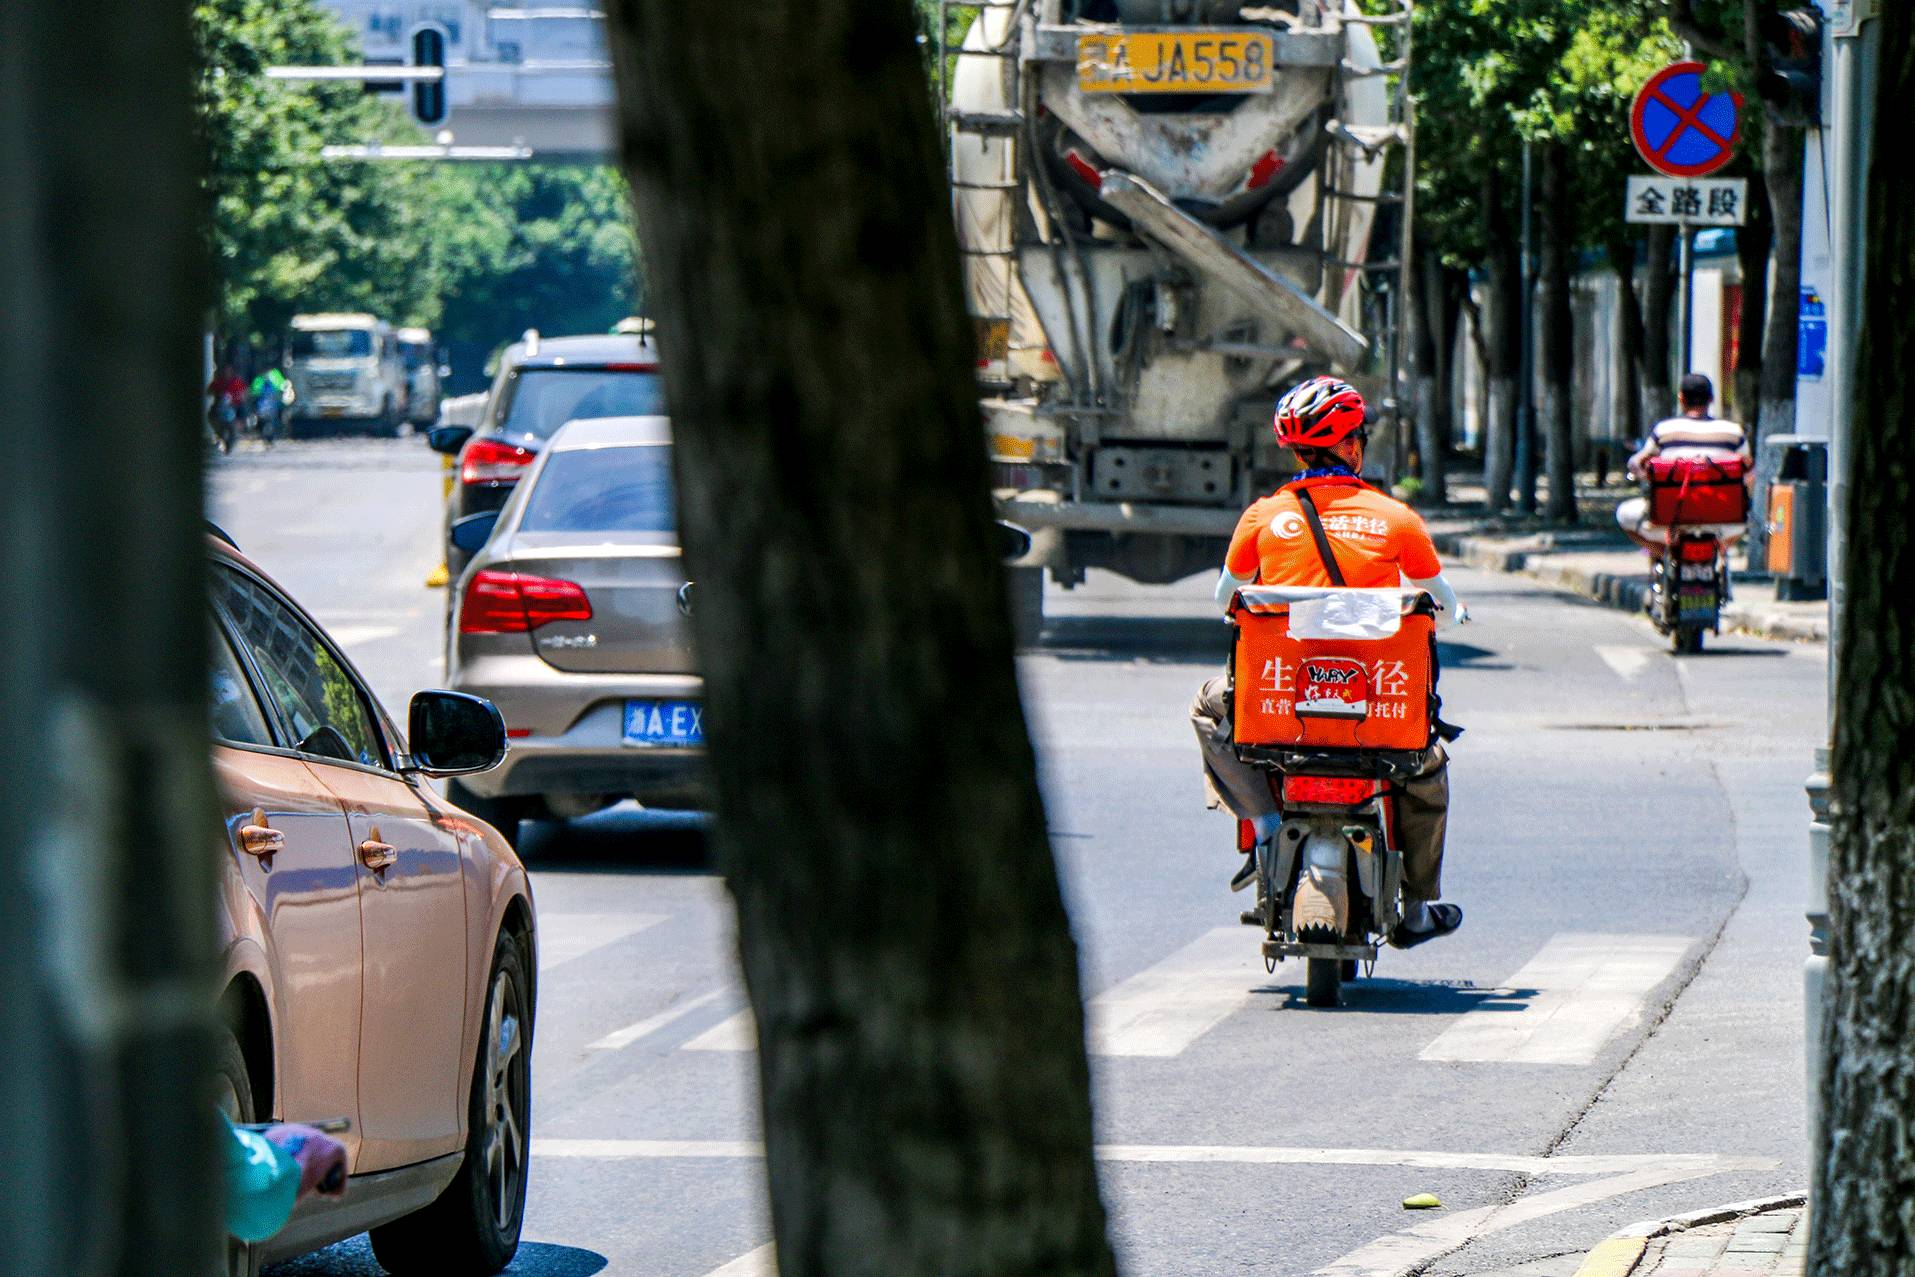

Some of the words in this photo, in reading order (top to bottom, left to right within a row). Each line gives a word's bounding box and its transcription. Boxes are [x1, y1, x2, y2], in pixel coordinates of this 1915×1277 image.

[1144, 40, 1265, 82] JA558
[1635, 185, 1737, 217] 全路段
